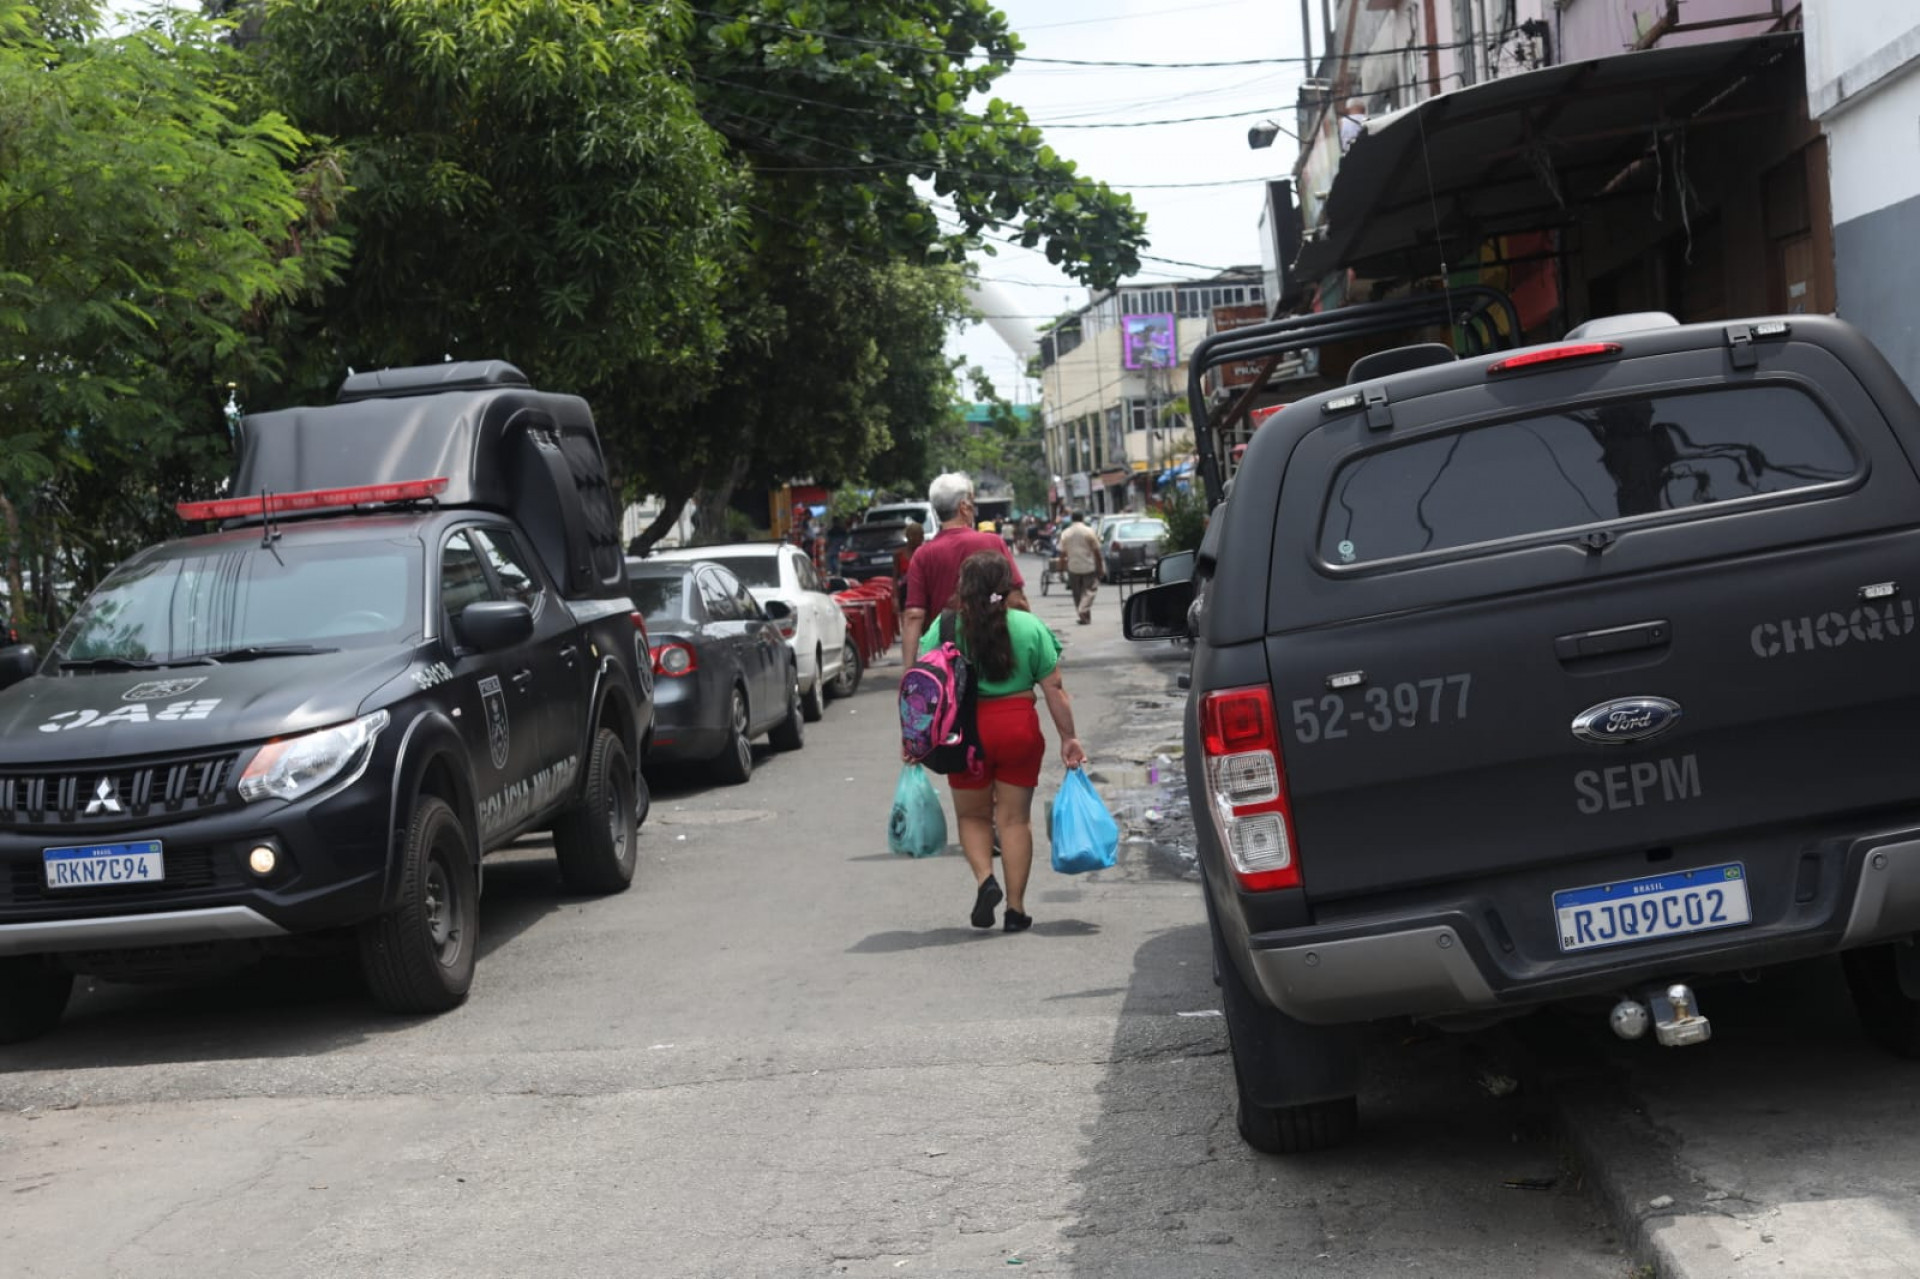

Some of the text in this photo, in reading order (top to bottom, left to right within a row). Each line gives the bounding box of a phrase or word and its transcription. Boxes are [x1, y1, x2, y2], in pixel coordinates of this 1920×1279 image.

[1750, 600, 1920, 658] CHOQU
[1292, 672, 1472, 744] 52-3977
[1606, 709, 1652, 733] Ford
[1573, 753, 1702, 815] SEPM
[56, 857, 149, 884] RKN7C94
[1633, 882, 1665, 894] BRASIL
[1573, 889, 1727, 944] RJQ9C02
[1564, 935, 1576, 947] BR
